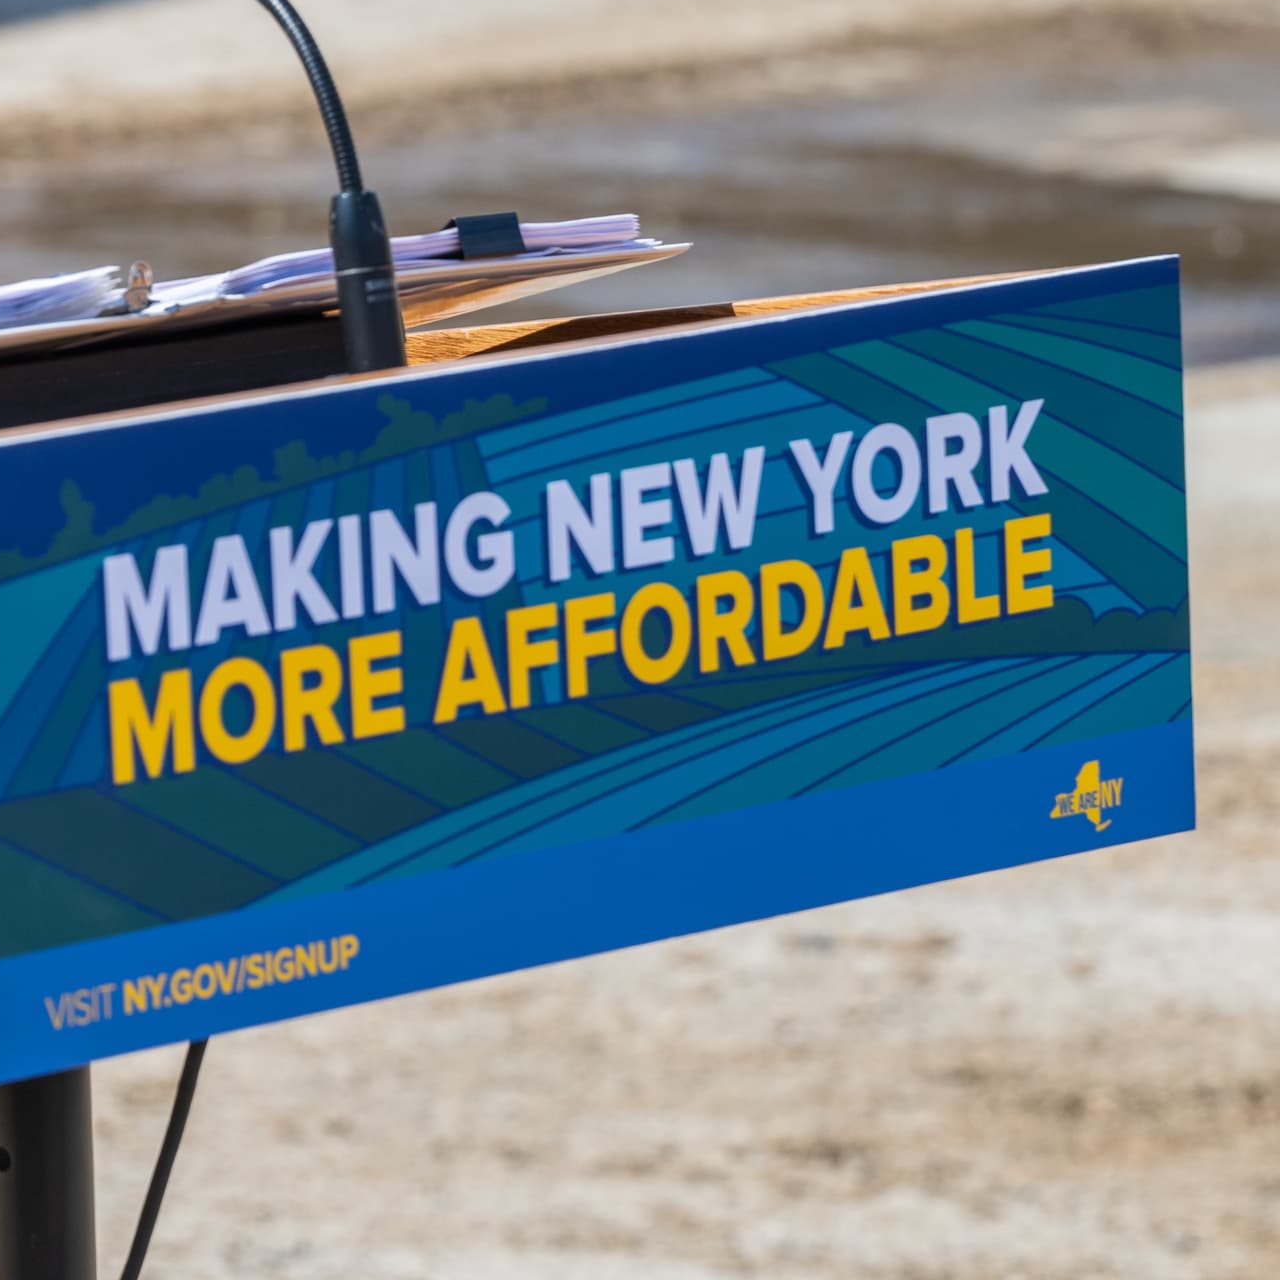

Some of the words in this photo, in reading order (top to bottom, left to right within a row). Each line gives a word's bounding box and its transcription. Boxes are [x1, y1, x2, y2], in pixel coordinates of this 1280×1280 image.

[103, 491, 516, 662] MAKING
[546, 445, 766, 583] NEW
[788, 398, 1049, 535] YORK
[108, 631, 406, 785] MORE
[433, 513, 1054, 724] AFFORDABLE
[1100, 777, 1123, 808] NY
[44, 983, 117, 1031] VISIT
[123, 934, 360, 1016] NY.GOV/SIGNUP
